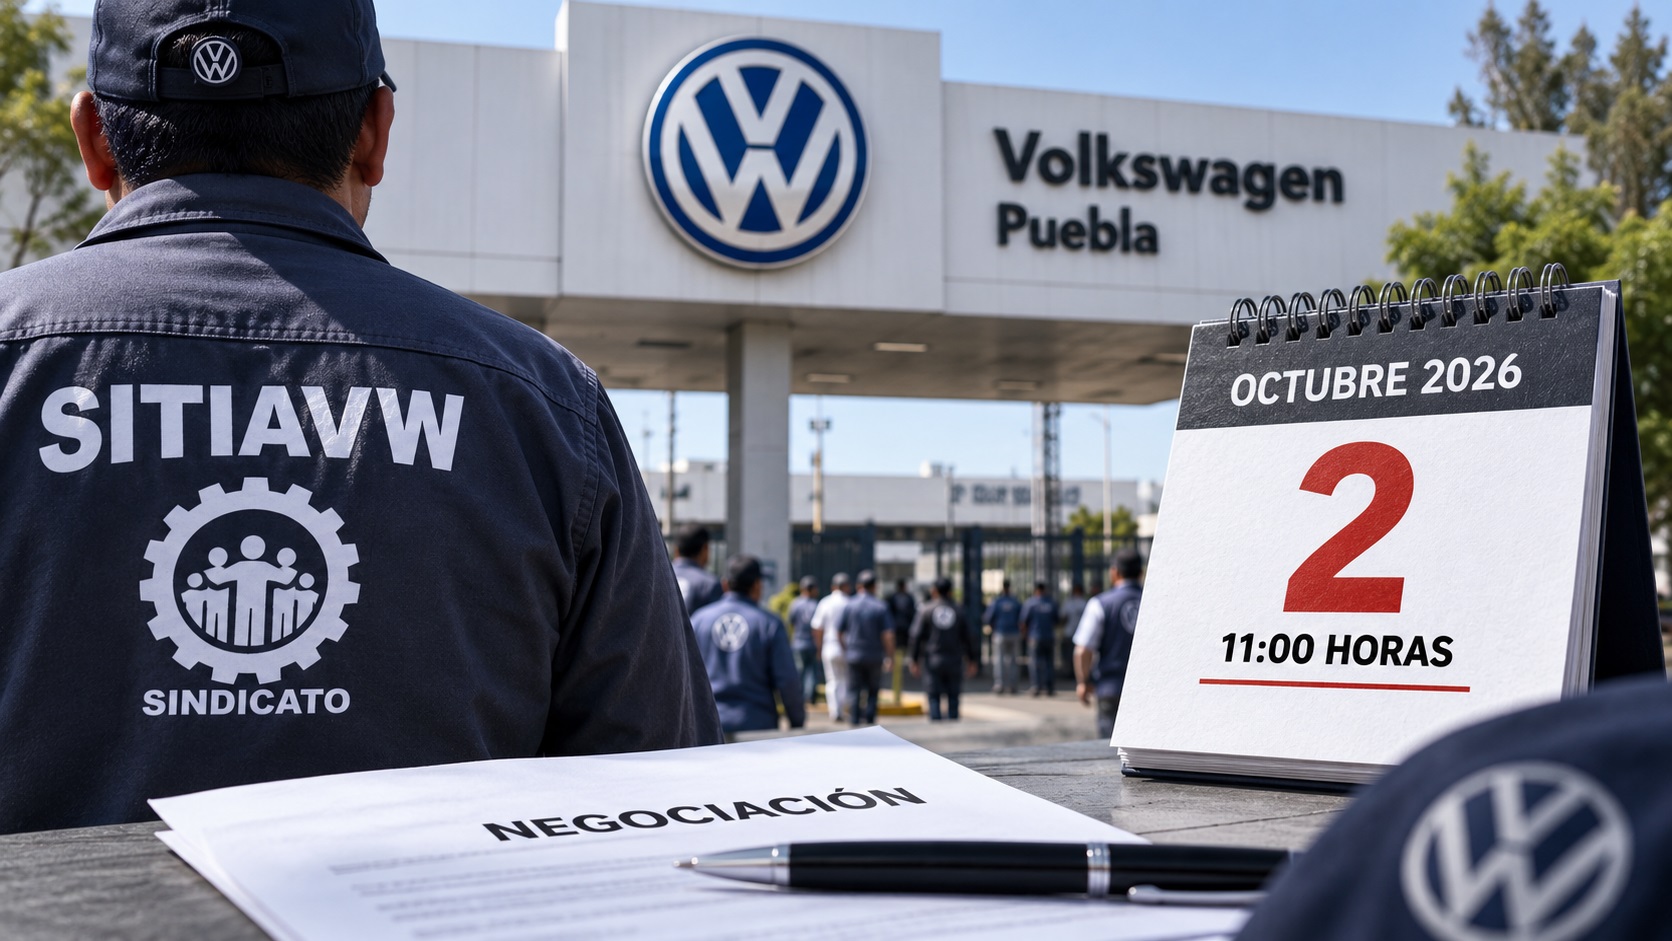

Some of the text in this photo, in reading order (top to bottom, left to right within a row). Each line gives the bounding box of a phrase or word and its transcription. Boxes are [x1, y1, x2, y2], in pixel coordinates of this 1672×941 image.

[193, 40, 238, 84] VW
[658, 48, 858, 252] VW
[993, 127, 1345, 213] Volkswagen
[997, 202, 1160, 256] Puebla
[1230, 352, 1522, 407] OCTUBRE 2026
[38, 383, 465, 474] SITIAVW
[1283, 441, 1416, 614] 2
[1222, 632, 1455, 669] 11:00 HORAS
[142, 688, 351, 716] SINDICATO
[482, 787, 927, 842] NEGOCIACIÓN
[1402, 763, 1632, 941] VW
